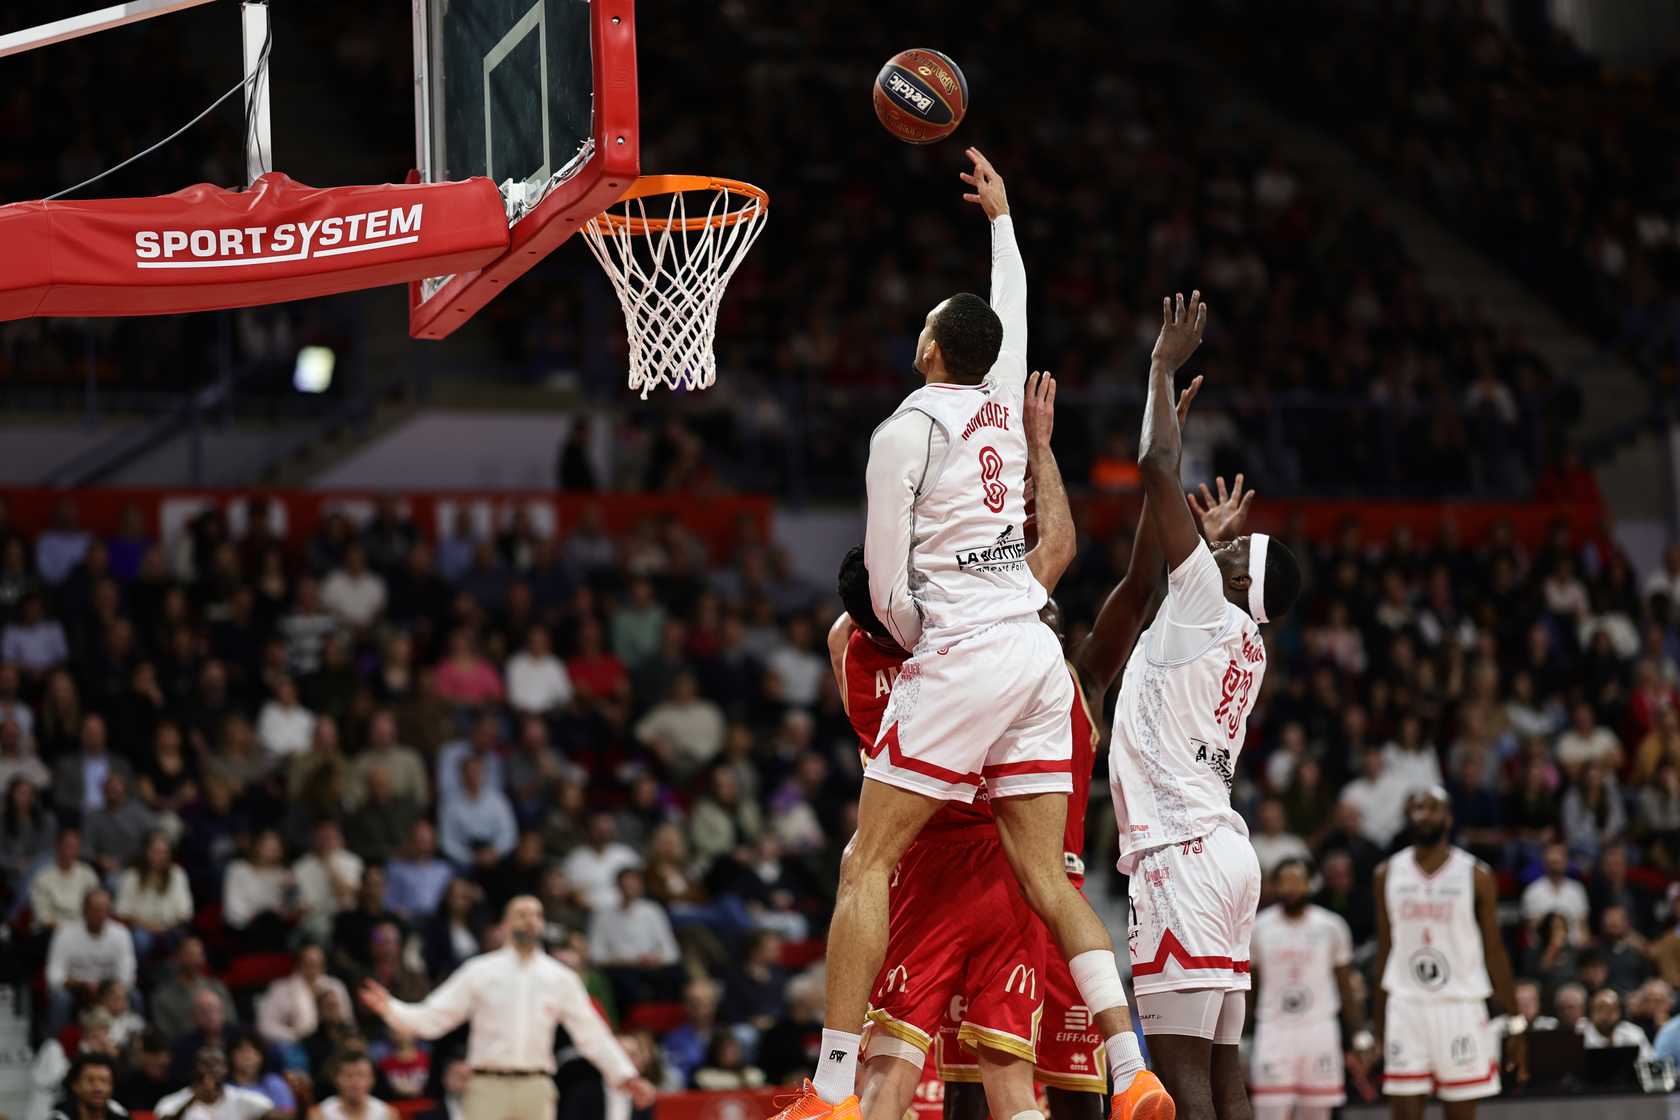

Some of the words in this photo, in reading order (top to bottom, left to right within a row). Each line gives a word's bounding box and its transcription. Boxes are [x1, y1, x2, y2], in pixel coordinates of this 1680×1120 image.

[889, 75, 932, 110] Betclic
[135, 227, 266, 258] SPORT
[271, 204, 422, 259] SYSTEM
[955, 553, 979, 565] LA
[1056, 1032, 1100, 1044] EIFFAGE
[829, 1049, 848, 1063] BW
